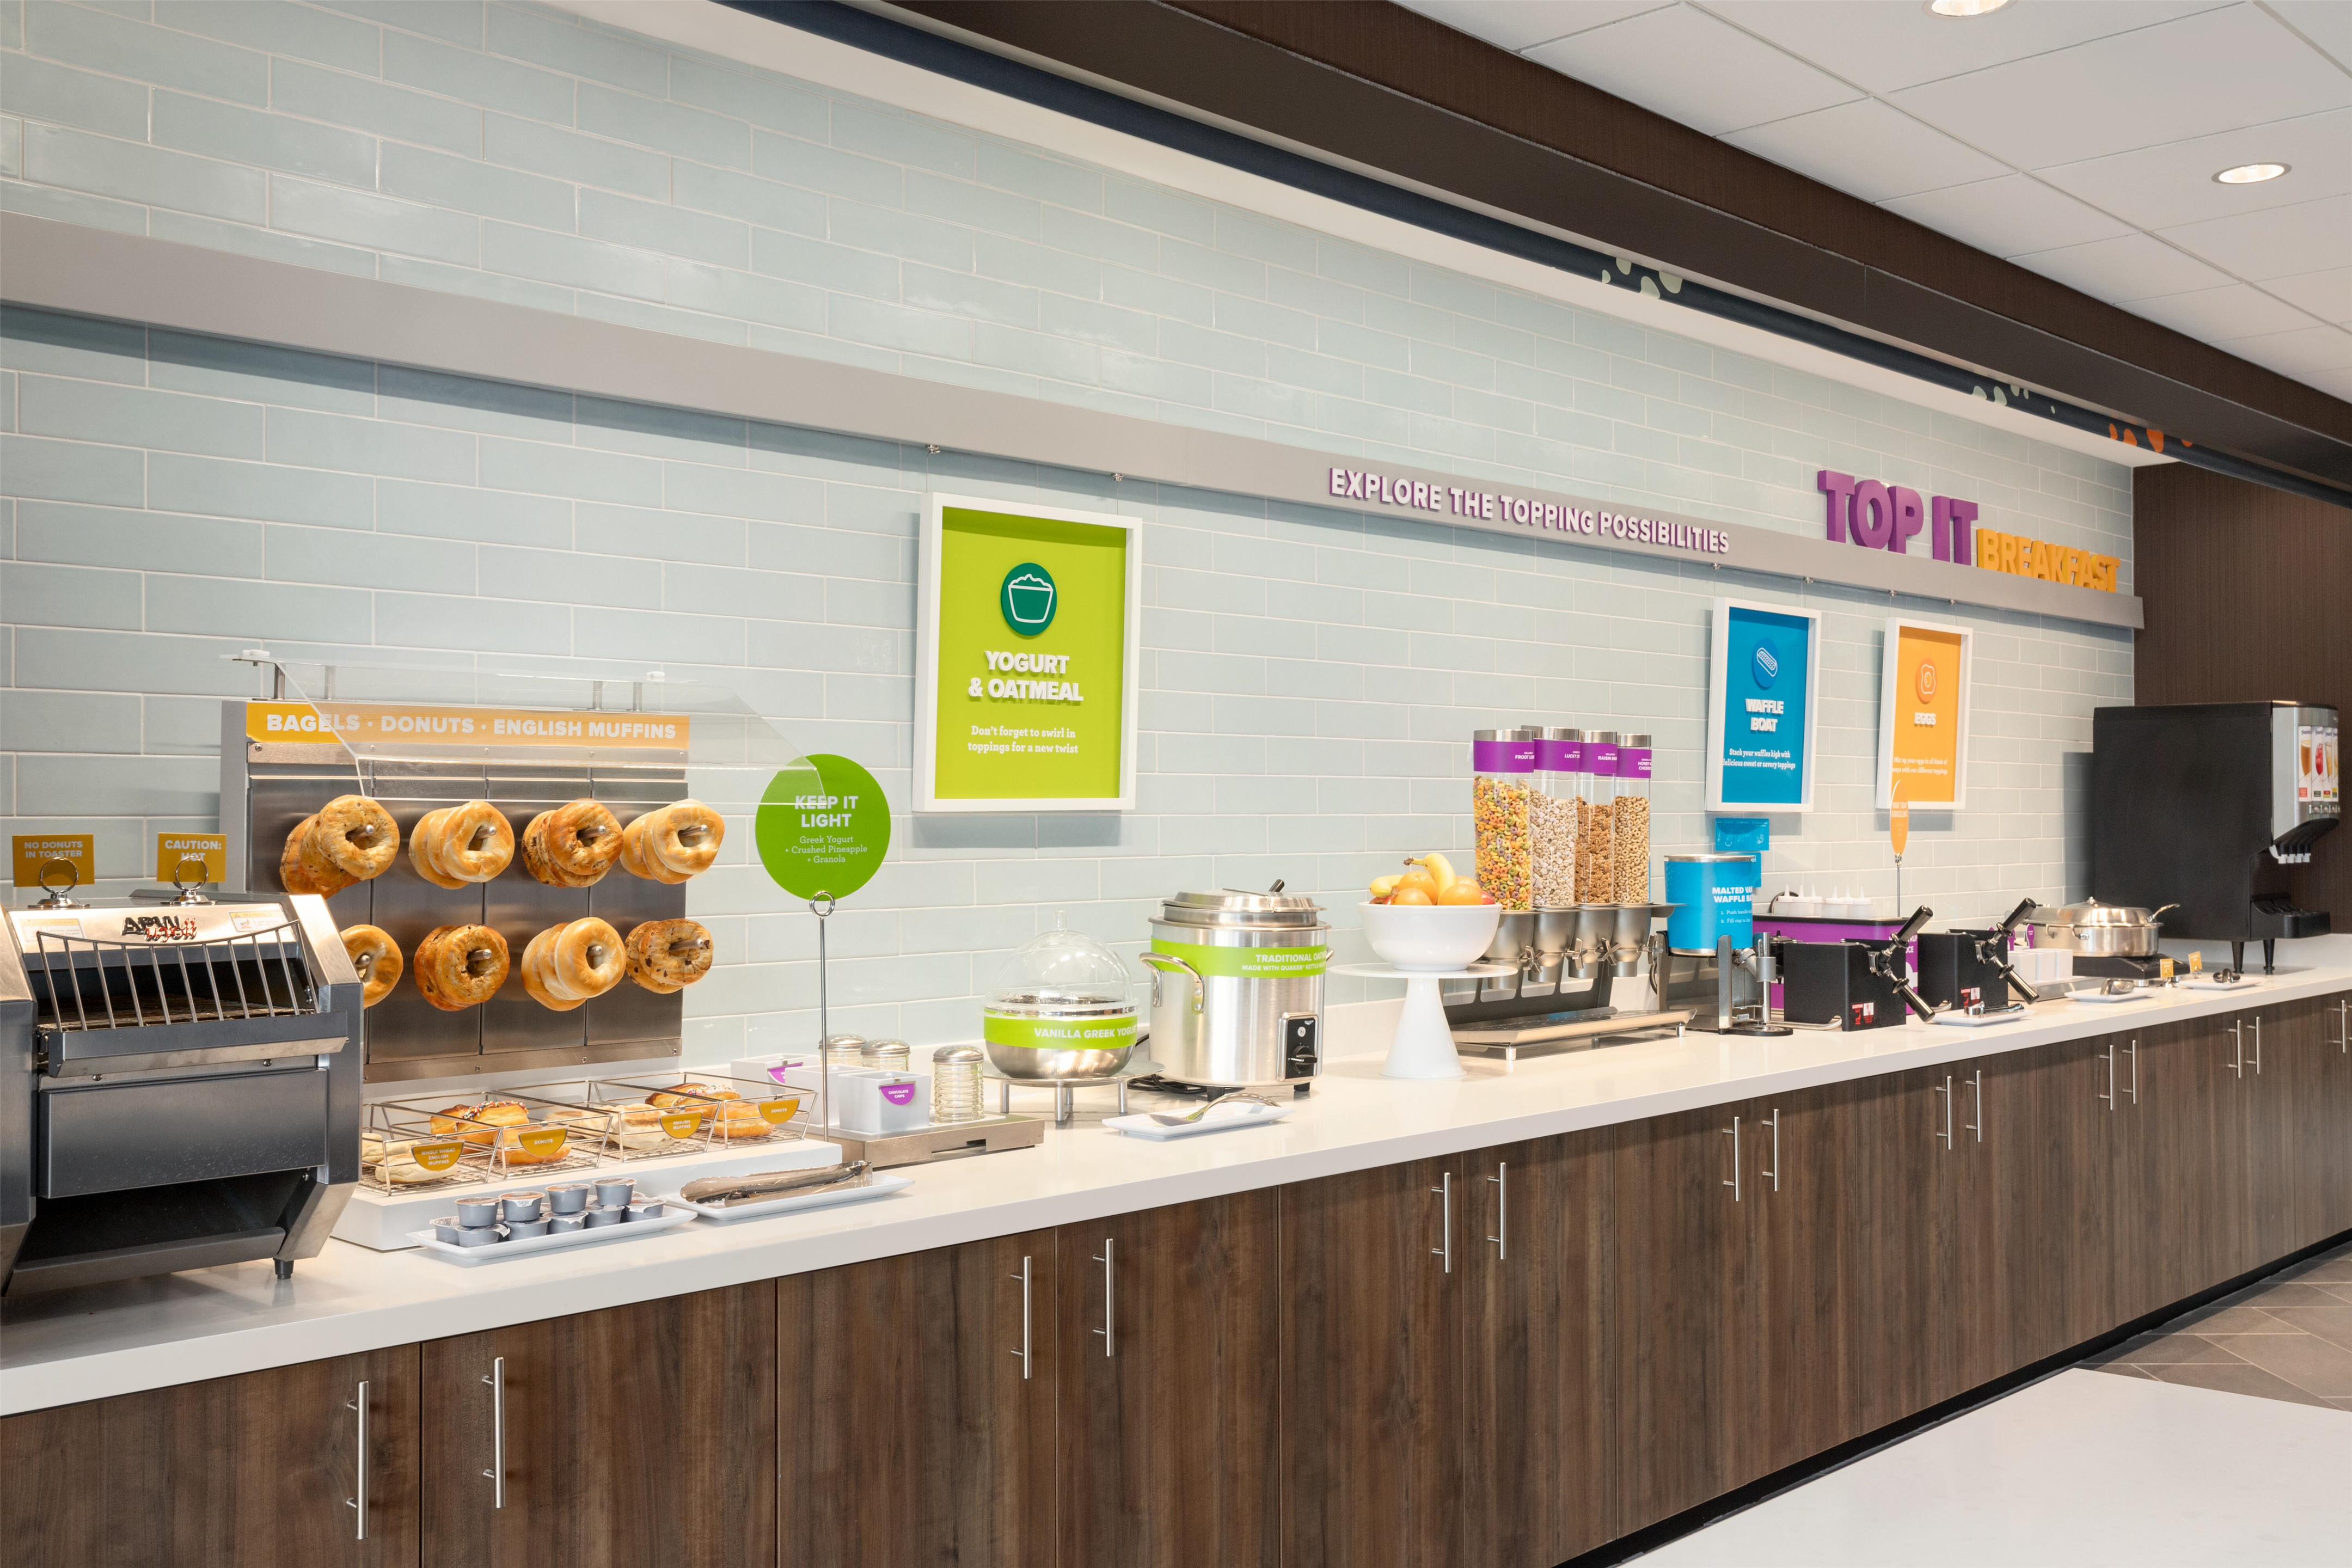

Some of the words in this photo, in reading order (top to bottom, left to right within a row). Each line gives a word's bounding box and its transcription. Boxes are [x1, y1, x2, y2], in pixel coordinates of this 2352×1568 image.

[1330, 468, 1442, 511] EXPLORE
[1448, 487, 1493, 518] THE
[1499, 494, 1594, 534] TOPPING
[1598, 511, 1729, 553] POSSIBILITIES
[1818, 470, 1924, 554] TOP
[1932, 495, 1978, 566] IT
[1977, 529, 2120, 593] BREAKFAST
[984, 651, 1070, 674] YOGURT
[968, 677, 983, 697] &
[988, 678, 1084, 701] OATMEAL
[1745, 698, 1784, 714] WAFFLE
[1750, 717, 1778, 732] BOAT
[1914, 712, 1936, 725] EGGS
[267, 714, 360, 732] BAGELS
[382, 715, 474, 733] DONUTS
[494, 719, 581, 737] ENGLISH
[589, 722, 676, 739] MUFFINS
[971, 725, 997, 736] Don’t
[999, 725, 1028, 739] forget
[1030, 728, 1039, 737] to
[1042, 727, 1064, 738] swirl
[1066, 728, 1075, 738] in
[968, 741, 1009, 754] toppings
[1012, 742, 1026, 751] for
[1055, 744, 1078, 753] twist
[1771, 749, 1780, 759] high
[1778, 761, 1796, 770] toppings
[795, 795, 838, 810] KEEP
[844, 796, 858, 809] IT
[801, 813, 852, 828] LIGHT
[165, 840, 222, 849] CAUTION:
[800, 835, 824, 843] Greek
[826, 835, 854, 844] Yogurt
[792, 845, 825, 854] Crushed
[828, 844, 867, 854] Pineapple
[181, 852, 206, 861] HOT
[813, 855, 846, 863] Granola
[1713, 895, 1745, 903] WAFFLE
[121, 916, 180, 935] APW
[1255, 954, 1312, 963] TRADITIONAL
[1034, 1028, 1081, 1038] VANILLA
[1084, 1028, 1115, 1039] GREEK
